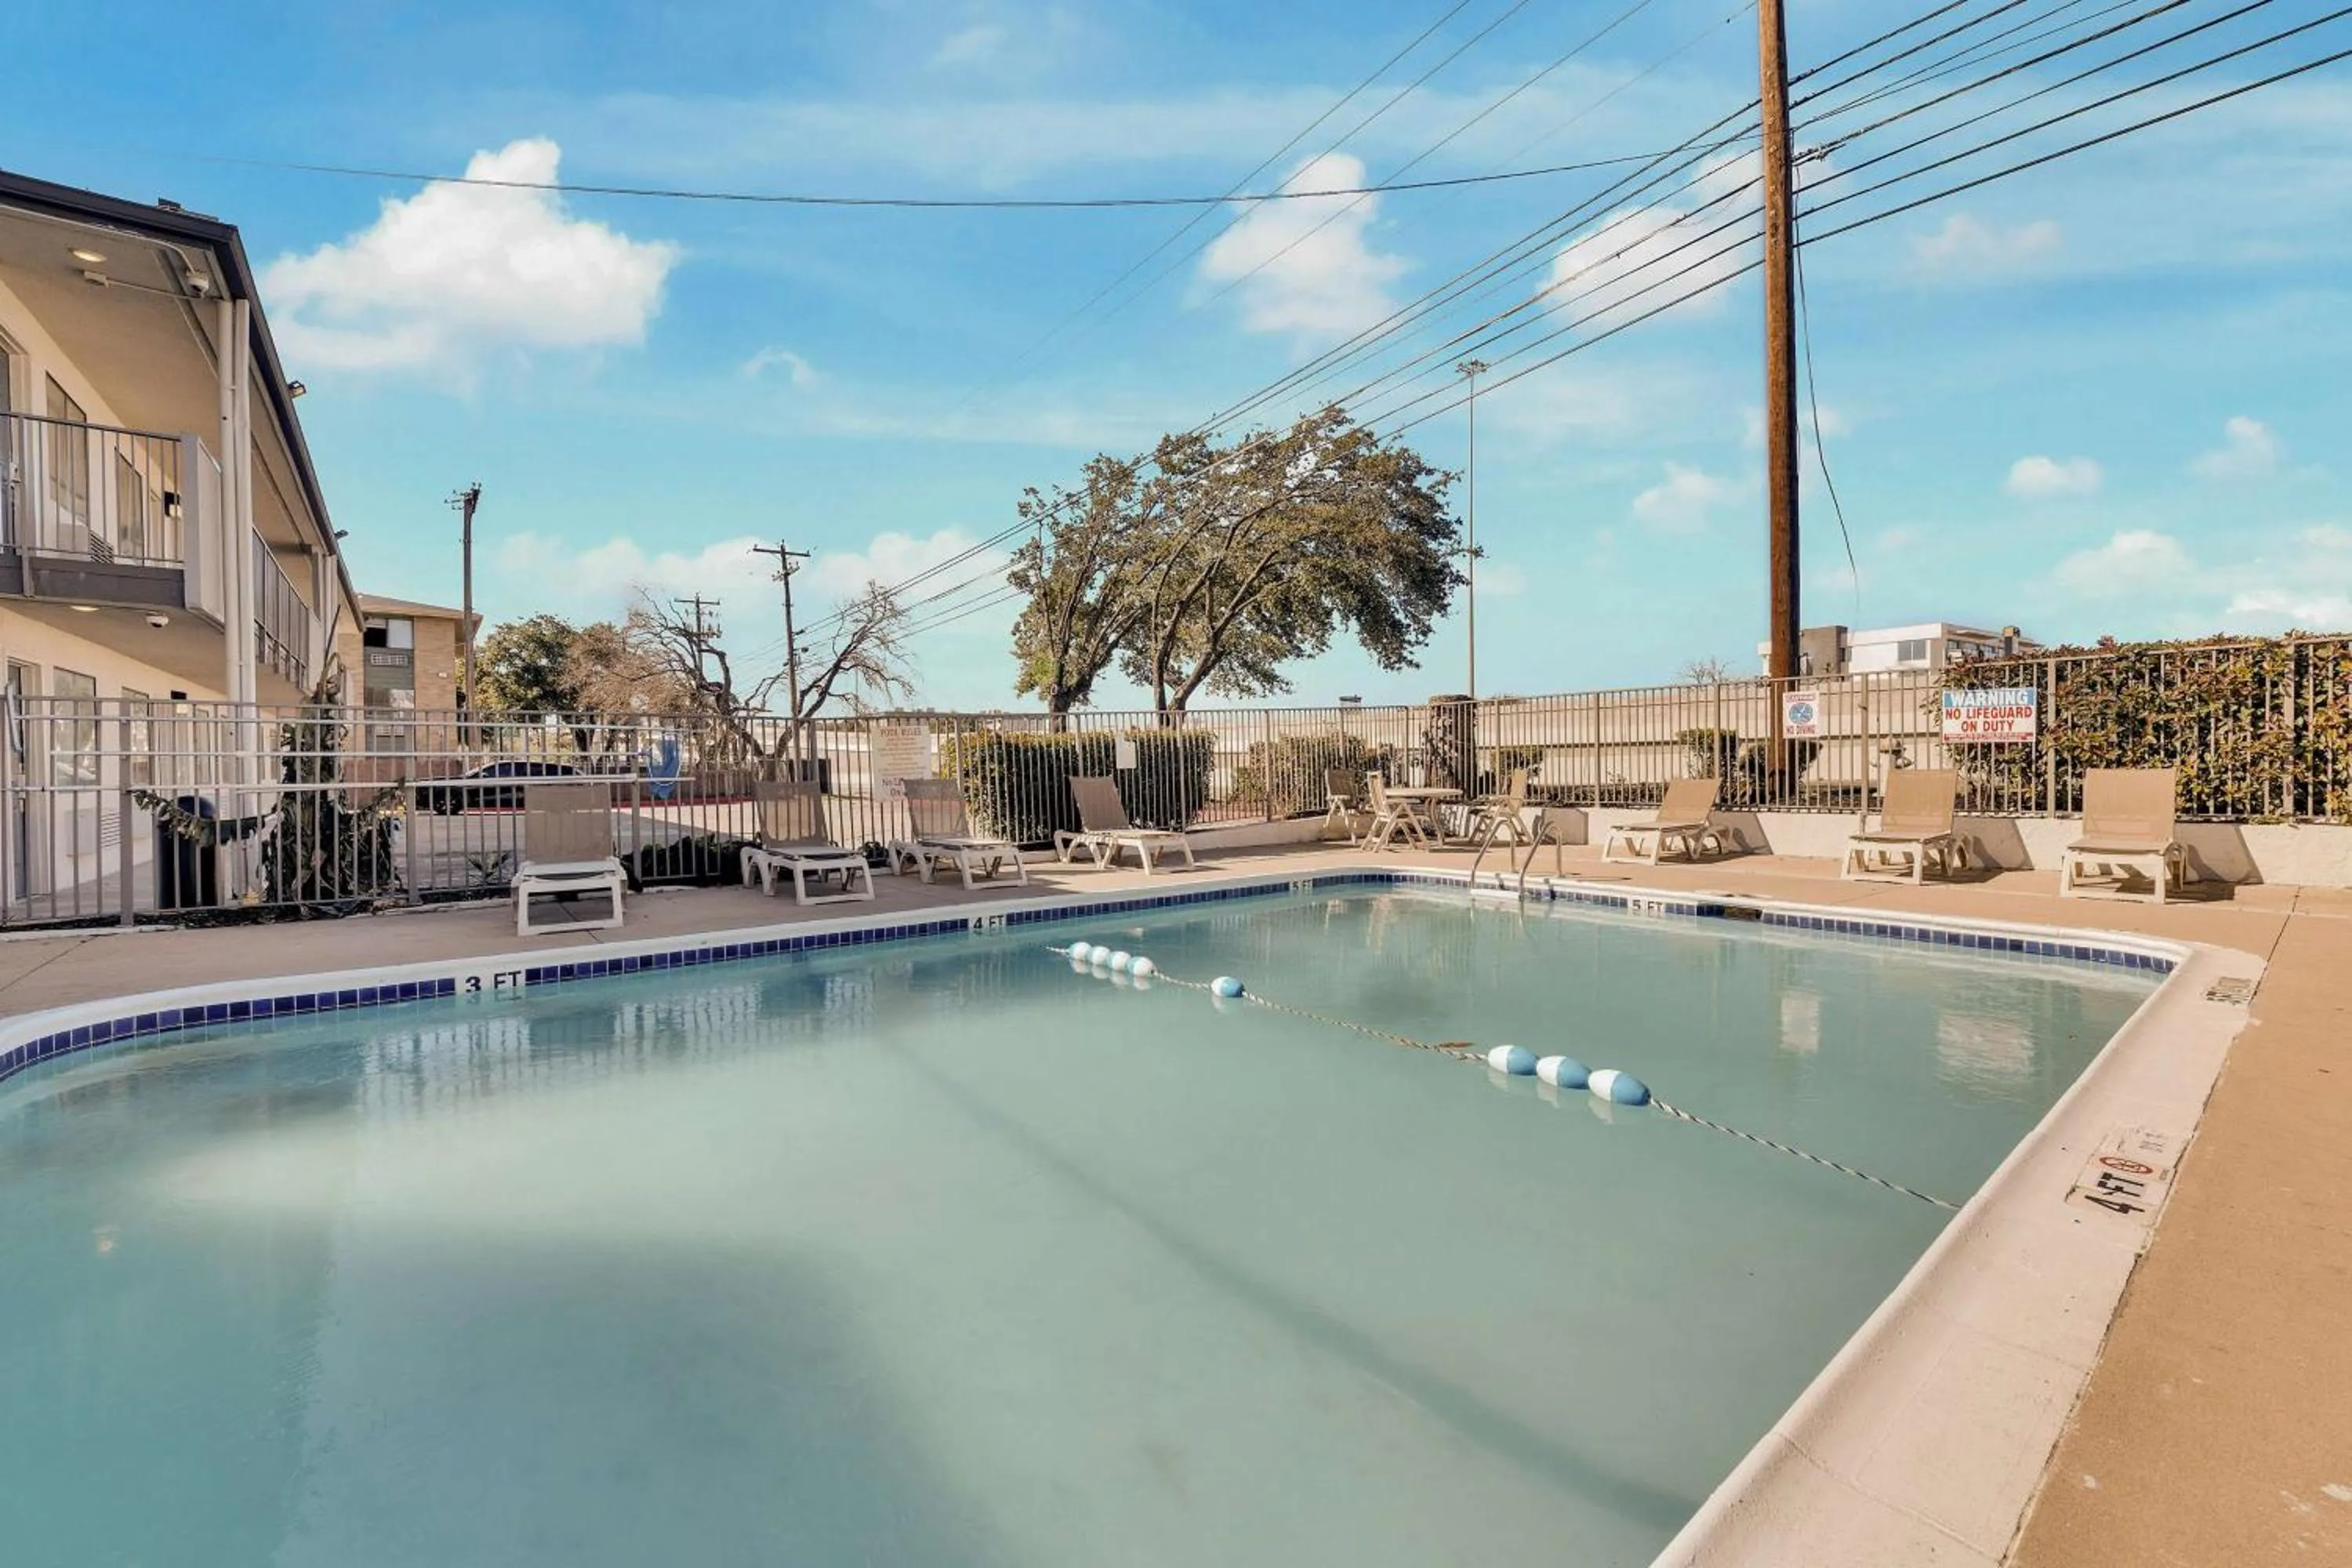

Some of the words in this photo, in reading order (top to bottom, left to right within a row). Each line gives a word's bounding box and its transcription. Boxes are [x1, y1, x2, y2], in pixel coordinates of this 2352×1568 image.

[1950, 690, 2029, 706] WARNING
[1945, 708, 1960, 720] NO
[1966, 706, 2032, 719] LIFEGUARD
[1962, 720, 1977, 731] ON
[1983, 720, 2014, 731] DUTY
[1632, 899, 1641, 910] 5
[1647, 901, 1662, 911] FT
[974, 916, 982, 928] 4
[989, 914, 1004, 927] FT
[465, 976, 481, 993] 3
[494, 971, 521, 989] FT
[2096, 1171, 2145, 1198] FT
[2084, 1194, 2146, 1214] 4
